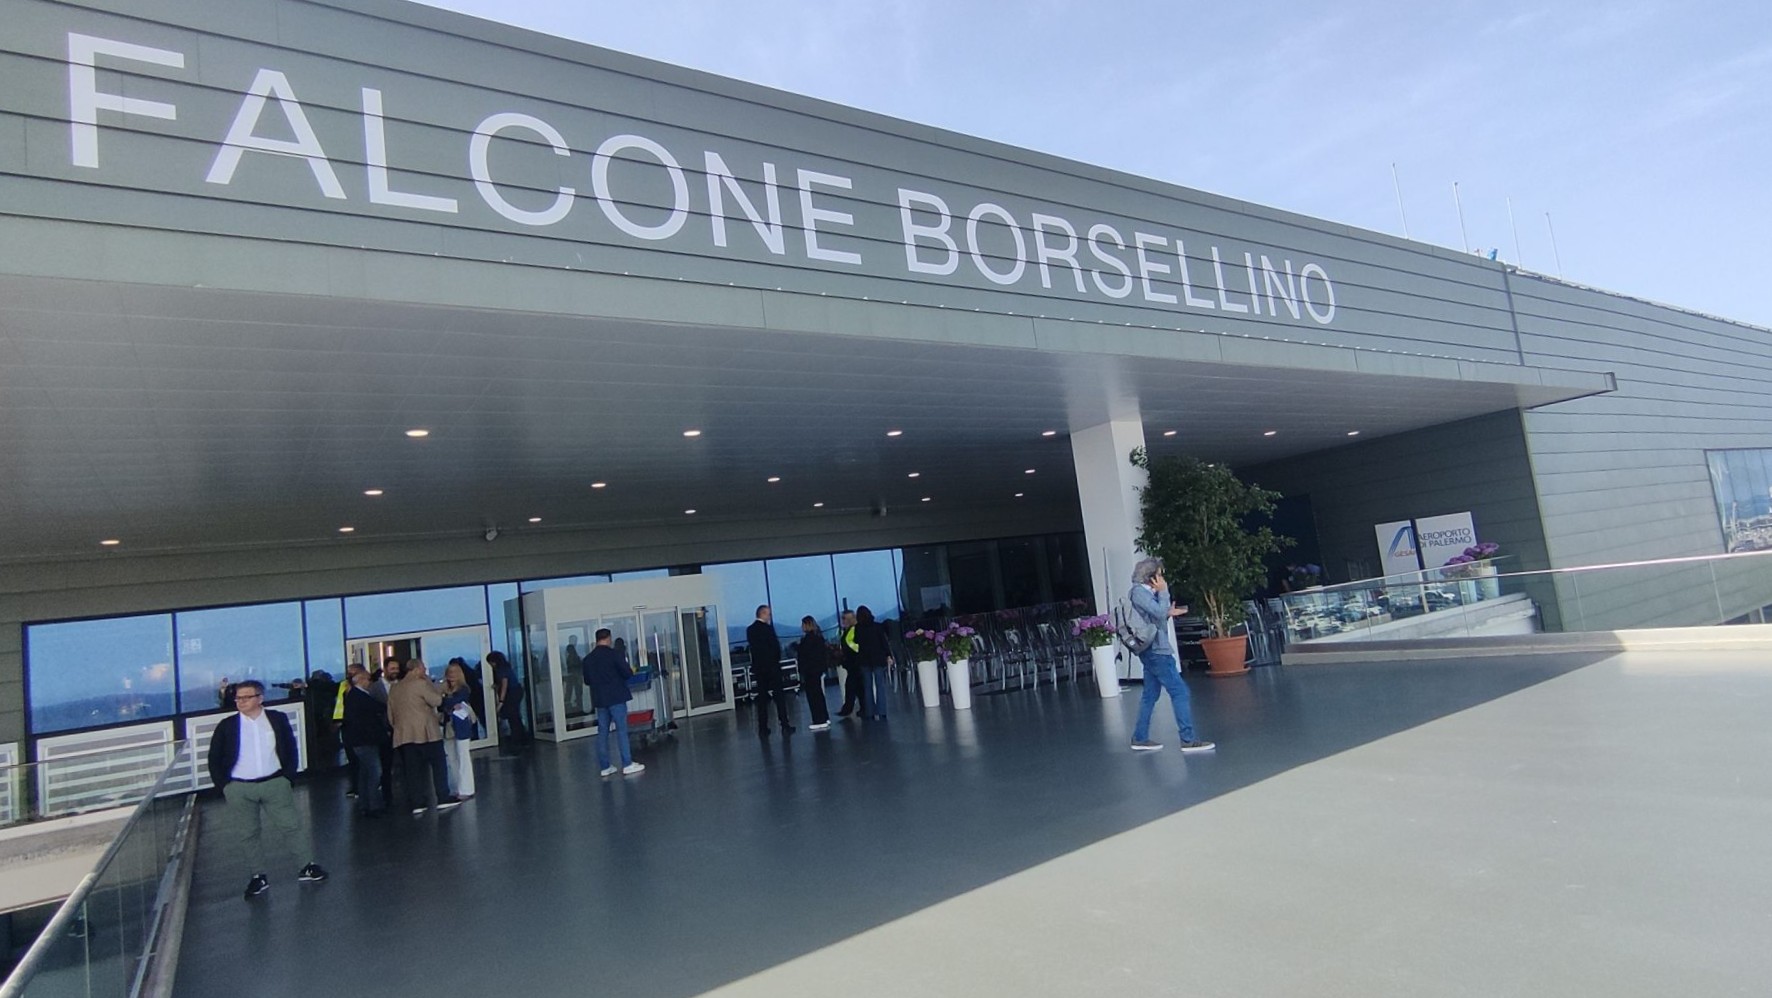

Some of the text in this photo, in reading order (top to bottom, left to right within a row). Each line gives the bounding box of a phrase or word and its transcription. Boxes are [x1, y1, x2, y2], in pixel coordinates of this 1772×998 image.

[68, 32, 1336, 325] FALCONE BORSELLINO
[1418, 528, 1470, 541] AEROPORTO
[1429, 536, 1472, 547] PALERMO
